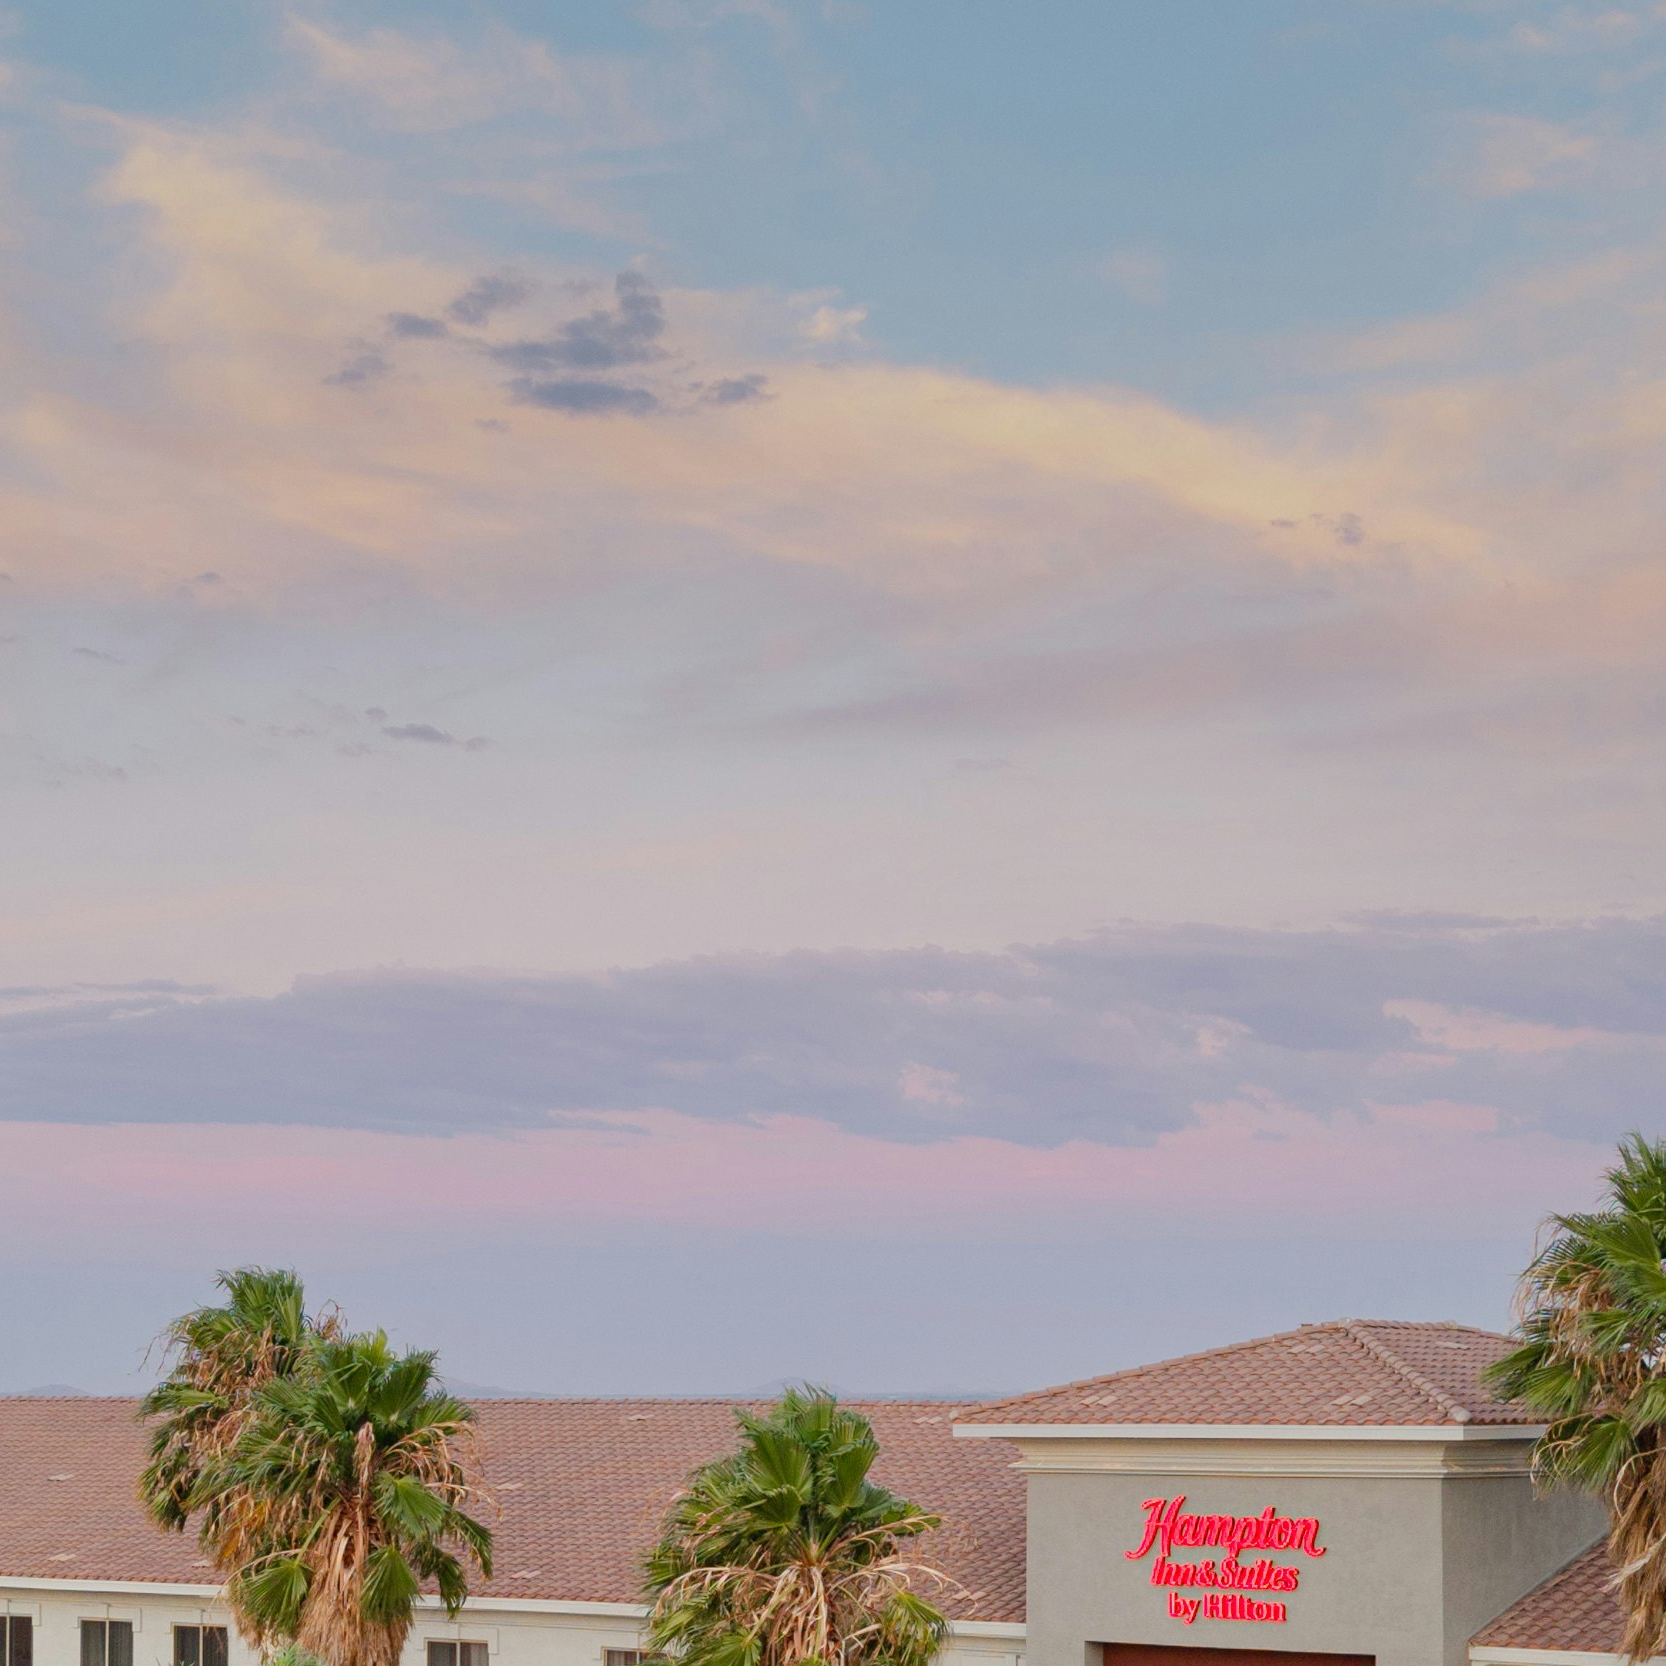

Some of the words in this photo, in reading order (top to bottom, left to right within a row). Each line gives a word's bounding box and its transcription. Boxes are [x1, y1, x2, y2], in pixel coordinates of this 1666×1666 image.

[1124, 1494, 1327, 1559] Hampton
[1150, 1556, 1197, 1587] Inn
[1218, 1557, 1300, 1592] Suites
[1168, 1591, 1201, 1625] by
[1203, 1592, 1288, 1622] Hilton
